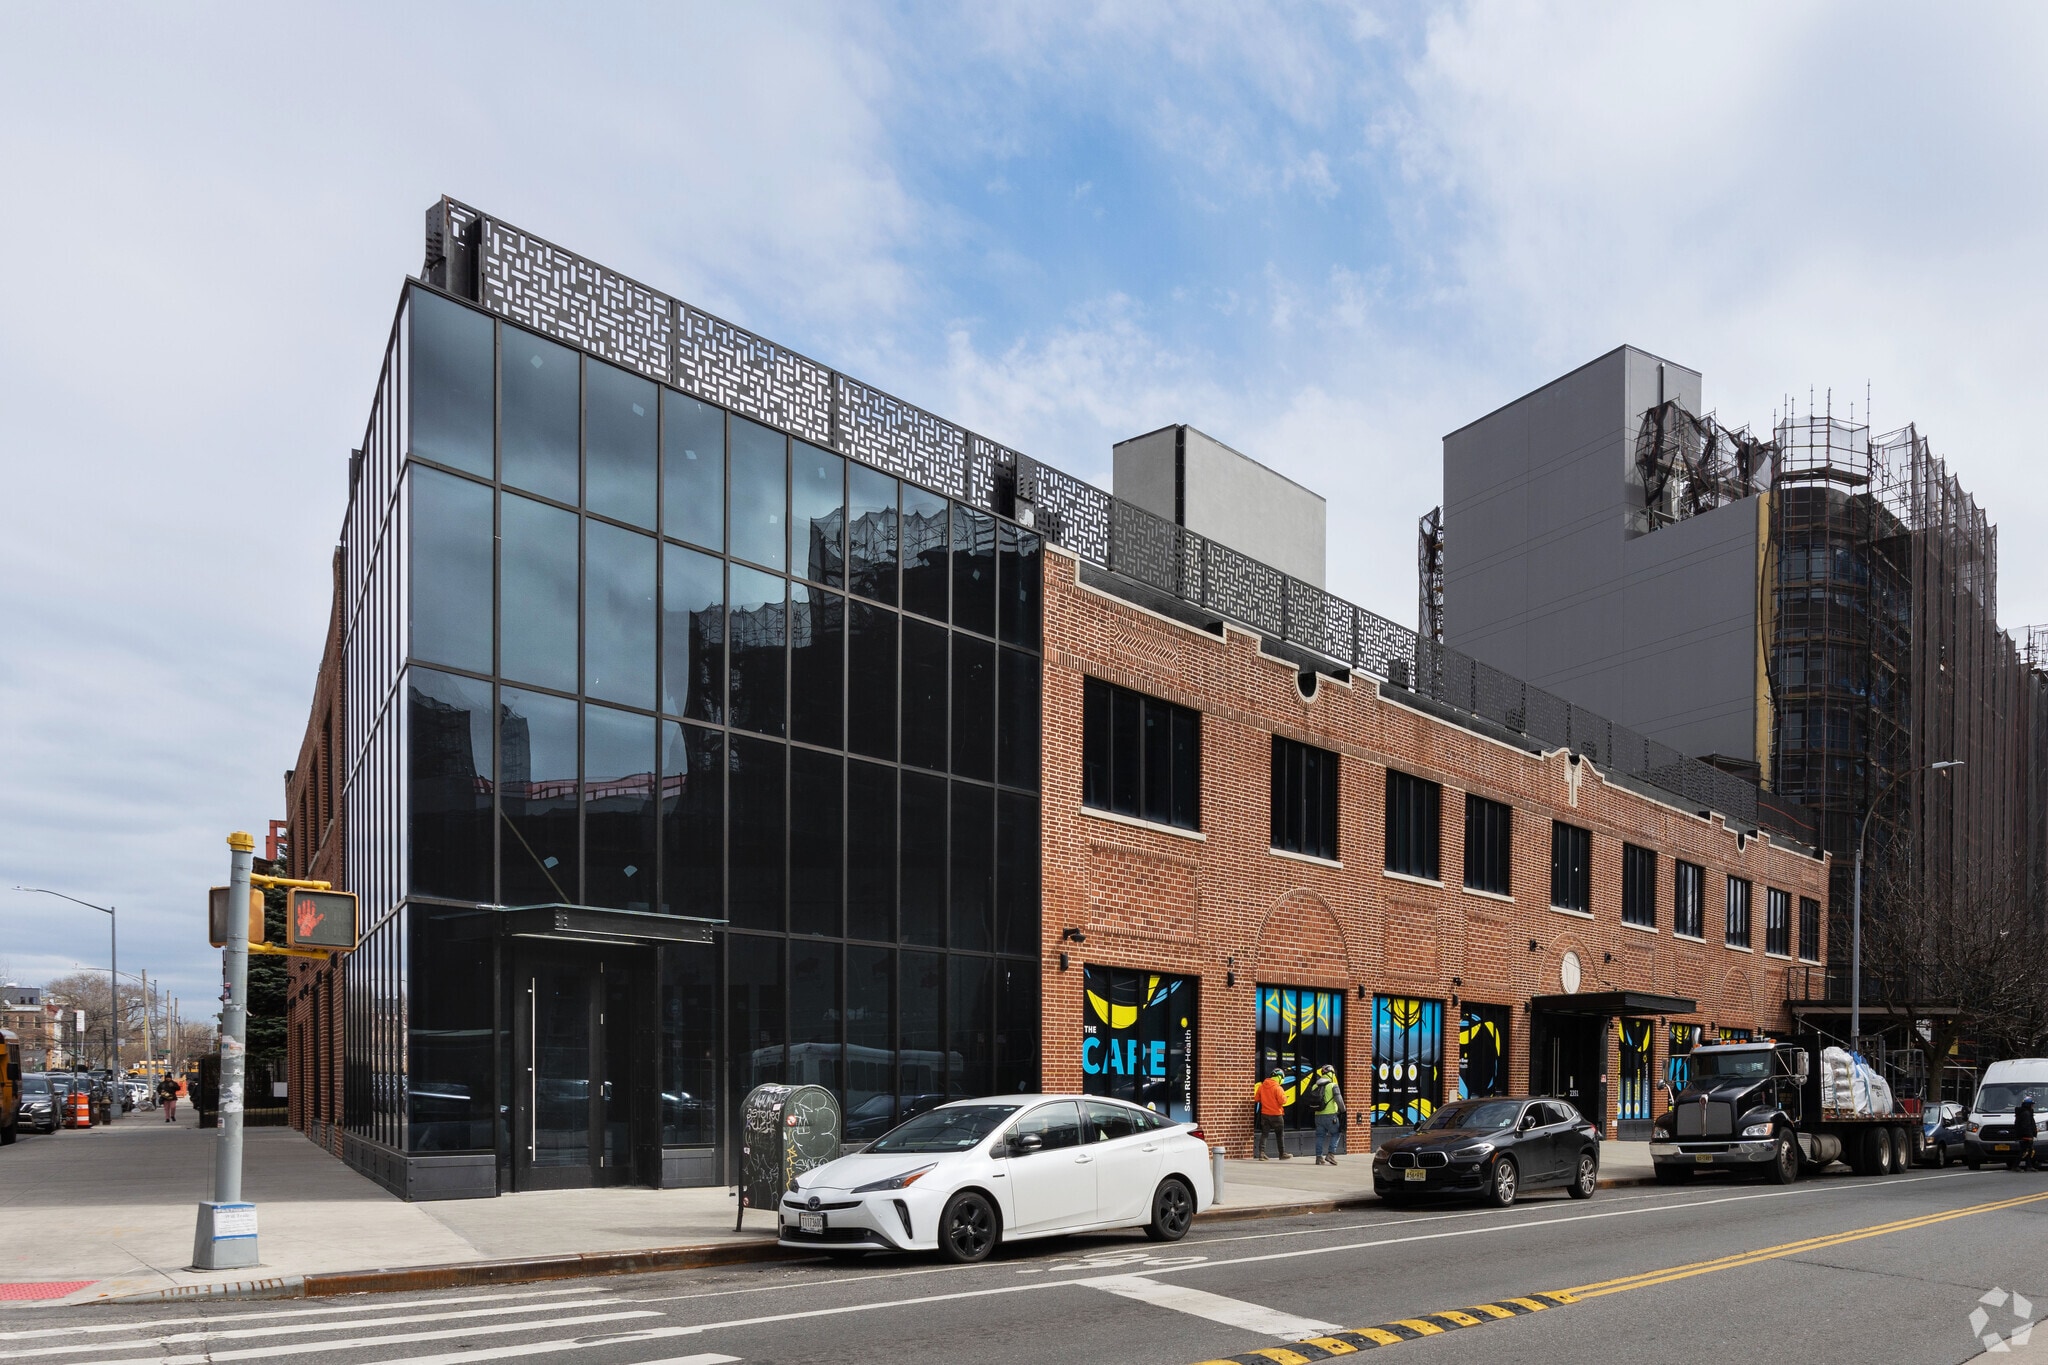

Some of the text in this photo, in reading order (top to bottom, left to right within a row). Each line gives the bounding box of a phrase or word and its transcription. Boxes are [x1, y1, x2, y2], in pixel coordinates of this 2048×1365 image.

[1084, 1025, 1097, 1034] THE
[1082, 1036, 1166, 1076] CARE
[1184, 1029, 1192, 1062] Health
[1183, 1092, 1191, 1112] Sun
